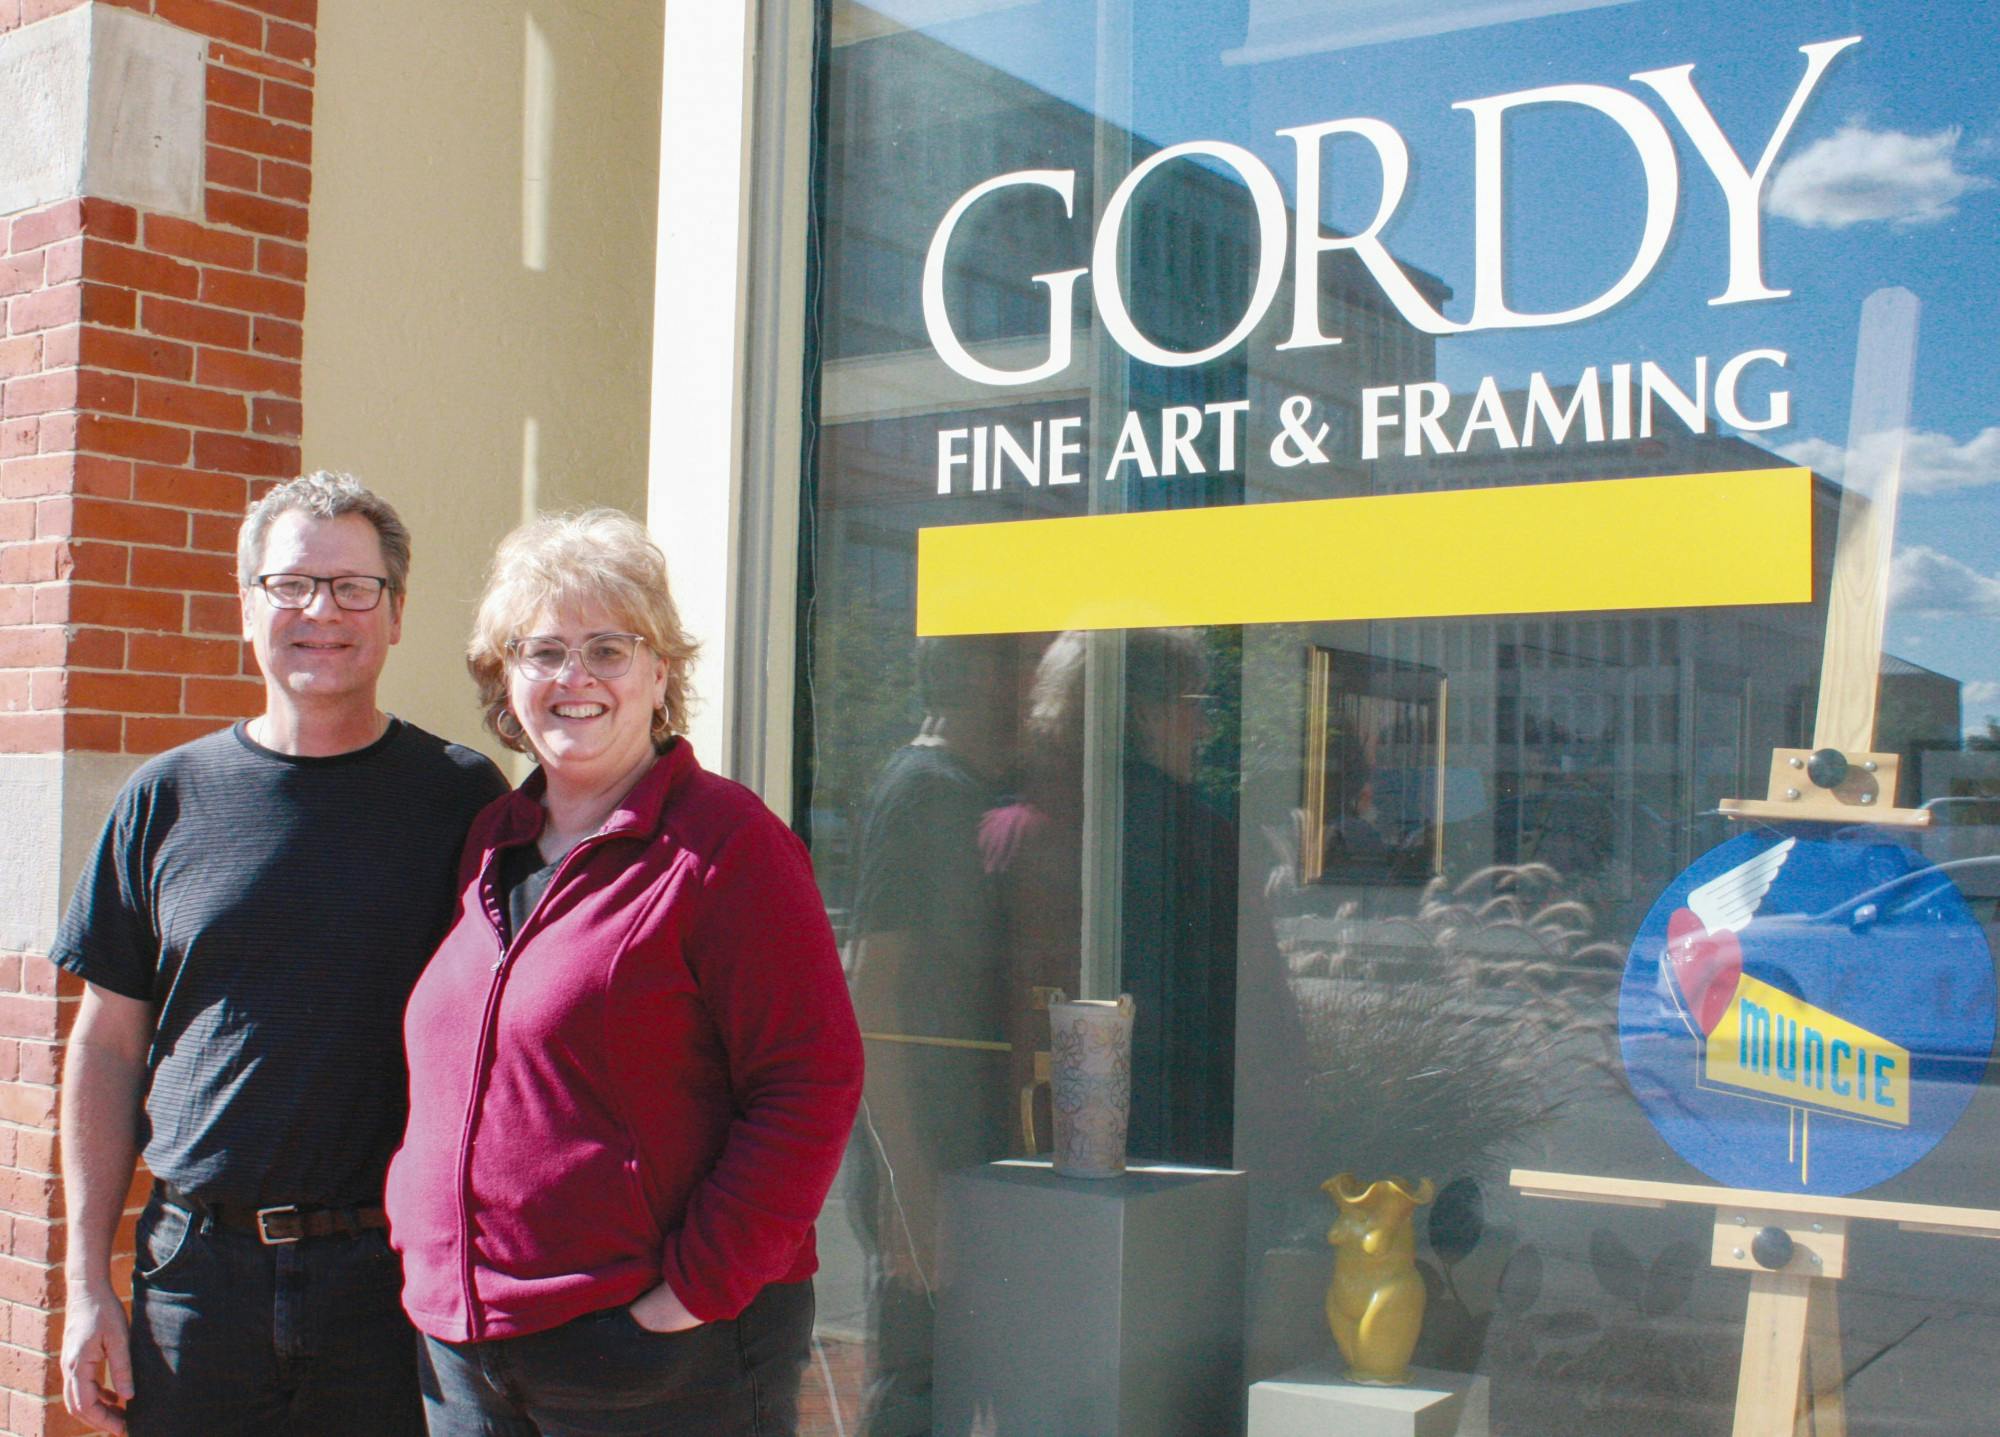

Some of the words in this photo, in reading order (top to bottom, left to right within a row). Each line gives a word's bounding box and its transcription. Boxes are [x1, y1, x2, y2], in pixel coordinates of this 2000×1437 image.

[921, 35, 1861, 387] GORDY
[936, 415, 1082, 496] FINE
[1106, 399, 1250, 481] ART
[1269, 395, 1329, 467] &
[1361, 349, 1789, 460] FRAMING
[1739, 996, 1896, 1107] MUNCIE
